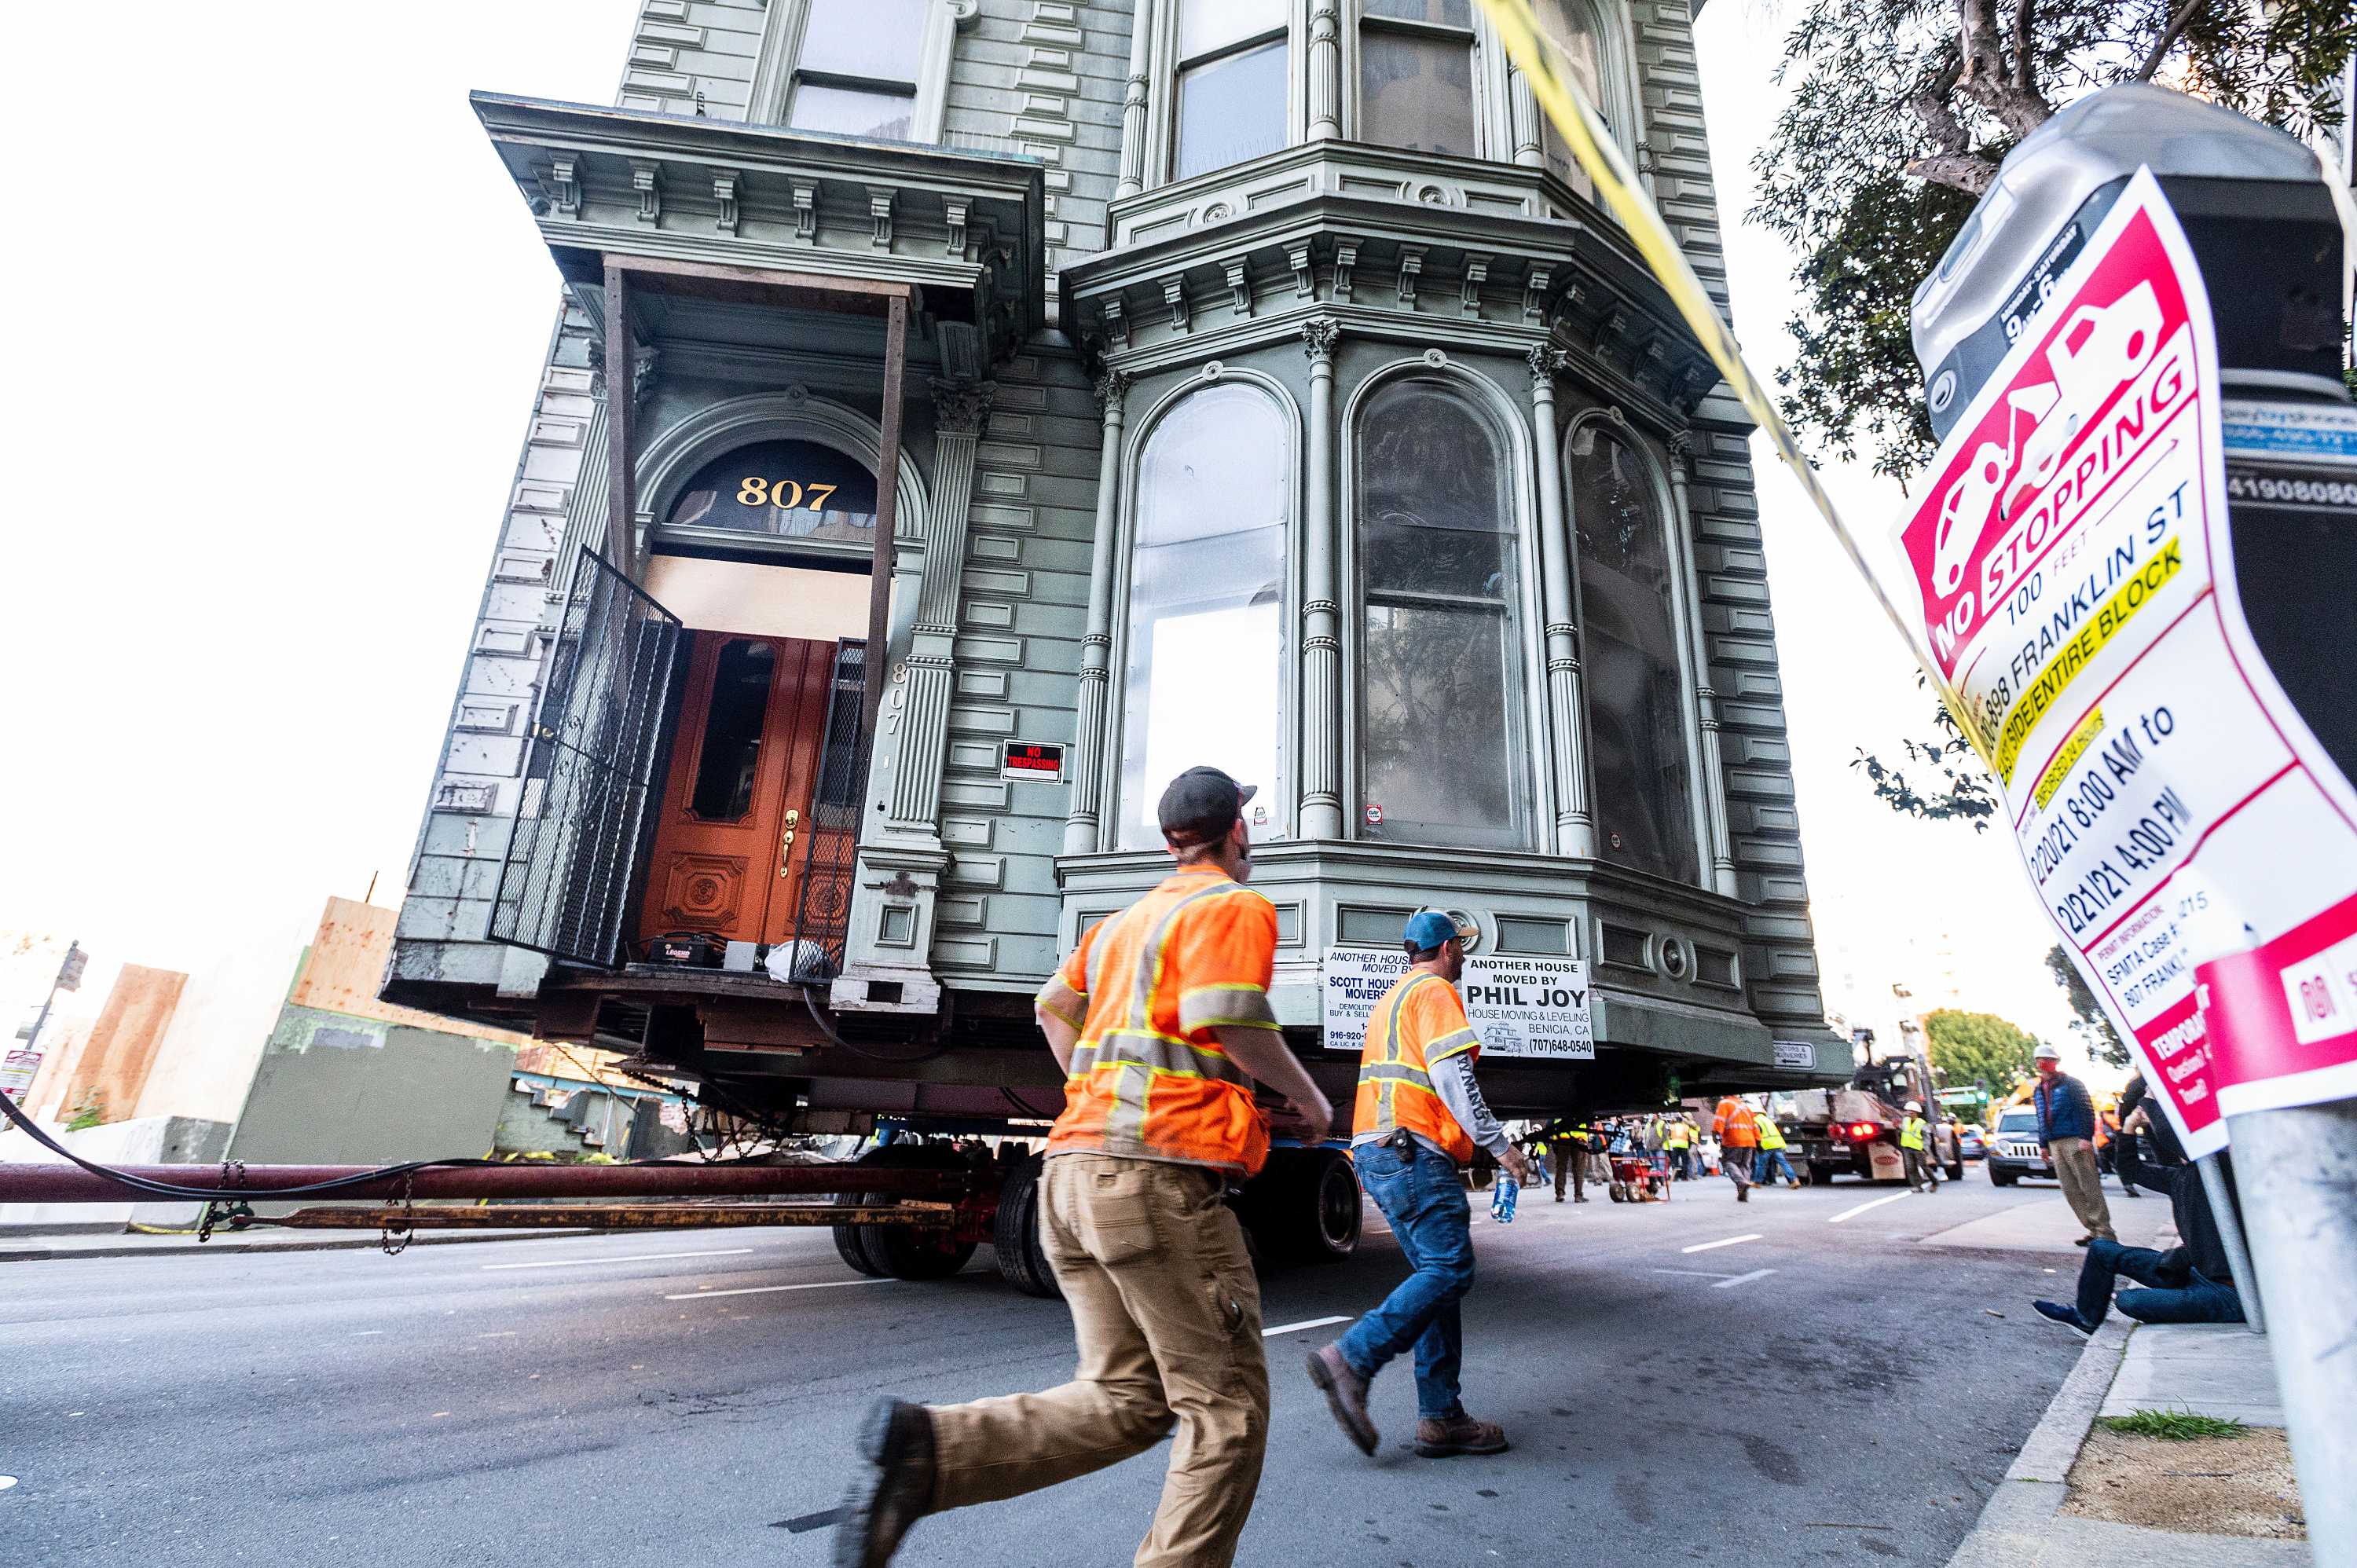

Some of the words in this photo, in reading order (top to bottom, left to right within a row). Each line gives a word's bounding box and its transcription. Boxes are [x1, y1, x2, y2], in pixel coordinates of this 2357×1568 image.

[736, 476, 838, 511] 807
[1936, 592, 1975, 663] NO
[1989, 355, 2182, 599] STOPPING
[2007, 572, 2042, 626] 100
[2054, 529, 2089, 577] FEET
[2011, 534, 2135, 689] FRANKLIN
[2147, 480, 2189, 544] ST
[2006, 630, 2095, 751] SIDE/ENTIRE
[2101, 548, 2182, 639] BLOCK
[1027, 746, 1041, 758] NO
[1007, 756, 1060, 771] TRESPASSING
[2031, 813, 2078, 886] 2/20/21
[2068, 770, 2114, 829] 8:00
[2102, 727, 2144, 786] AM
[2141, 707, 2173, 746] to
[2058, 860, 2131, 934] 2/21/21
[2115, 818, 2173, 870] 4:00
[2142, 932, 2172, 959] Case
[1330, 952, 1376, 963] ANOTHER
[1362, 964, 1397, 973] MOVED
[1471, 959, 1531, 971] ANOTHER
[1535, 962, 1578, 973] HOUSE
[1329, 976, 1363, 988] SCOTT
[1368, 978, 1398, 989] HOUS
[1493, 975, 1537, 984] MOVED
[1541, 976, 1558, 986] BY
[1467, 985, 1528, 1006] PHIL
[1535, 988, 1585, 1008] JOY
[1468, 1009, 1500, 1019] HOUSE
[1501, 1010, 1538, 1020] MOVING
[1538, 1012, 1545, 1020] &
[1547, 1013, 1589, 1022] LEVELING
[1330, 1031, 1366, 1040] 916-920-
[1528, 1024, 1572, 1035] BENICIA,
[1574, 1025, 1590, 1035] CA
[1529, 1039, 1592, 1054] (707)648-0540
